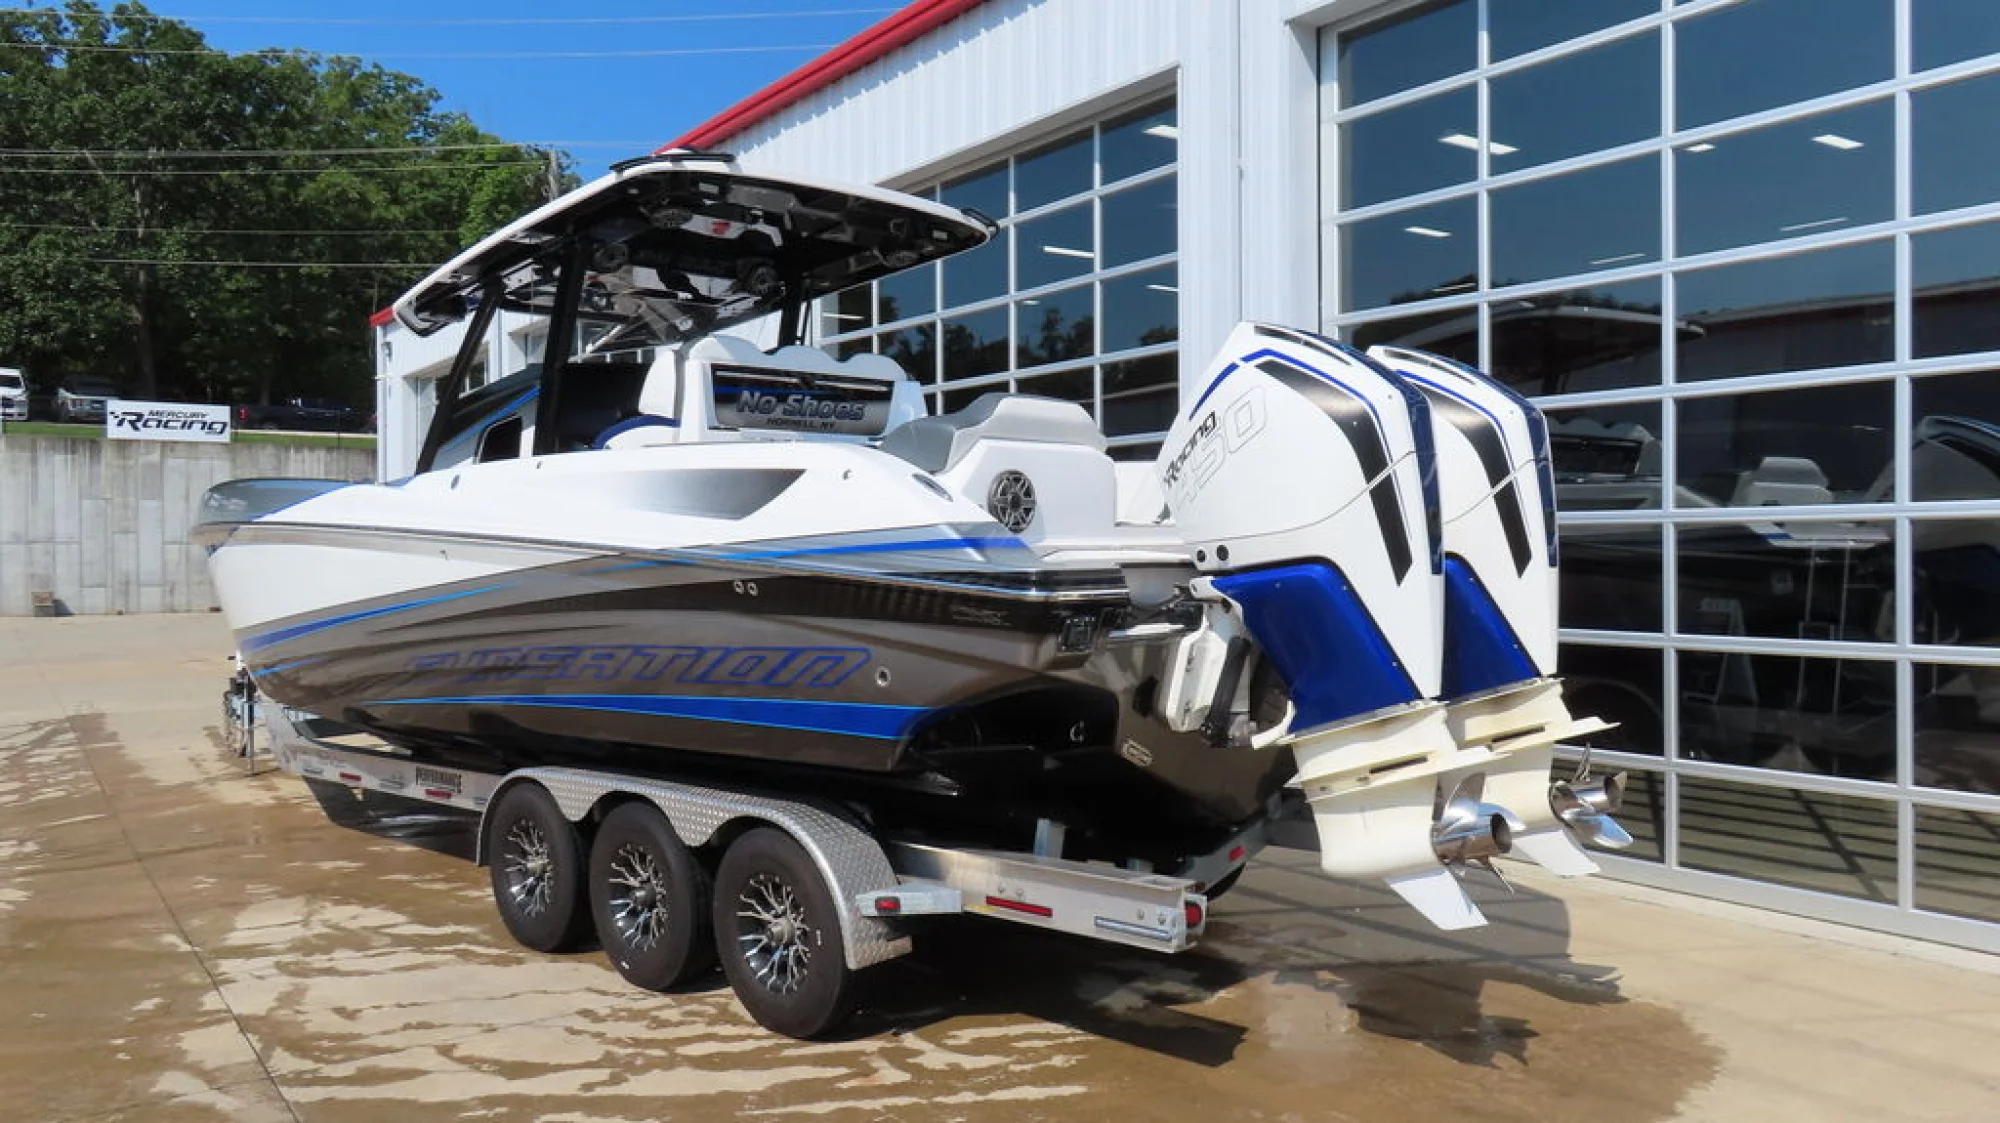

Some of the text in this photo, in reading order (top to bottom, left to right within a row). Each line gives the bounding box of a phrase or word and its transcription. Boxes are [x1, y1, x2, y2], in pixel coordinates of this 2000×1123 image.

[147, 410, 208, 419] MERCURY
[736, 390, 866, 421] No Shoes
[109, 411, 228, 434] Racing
